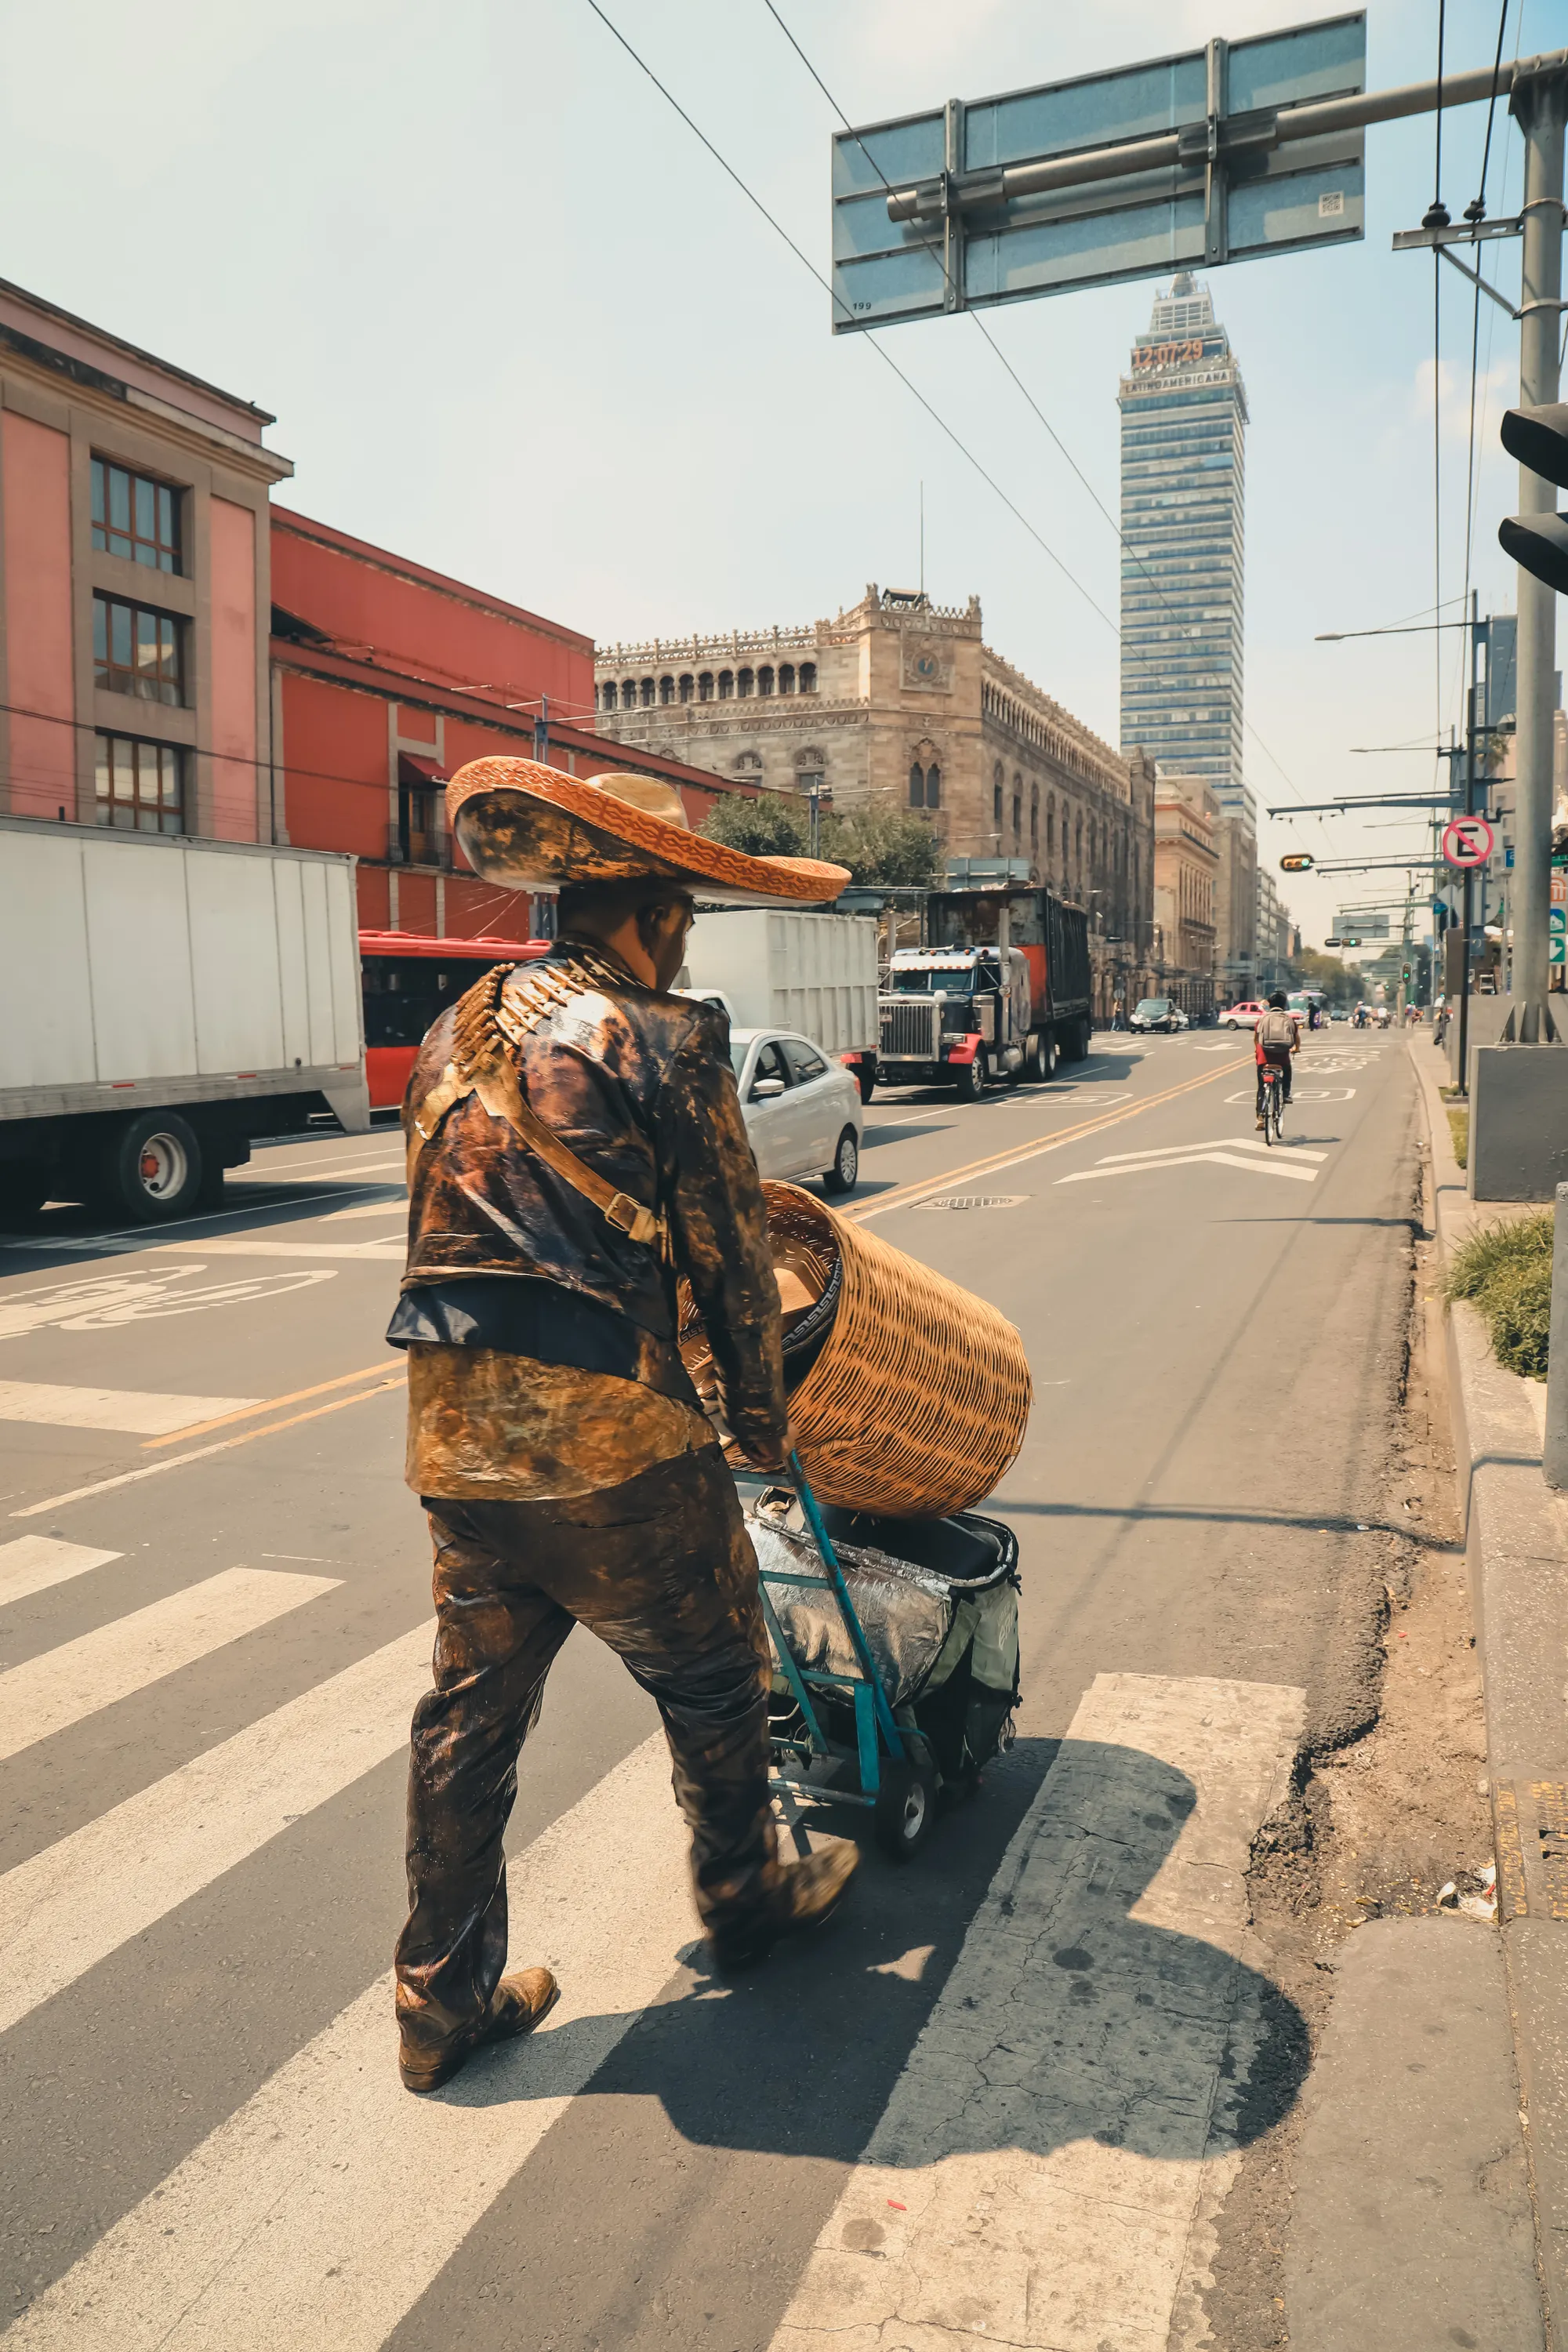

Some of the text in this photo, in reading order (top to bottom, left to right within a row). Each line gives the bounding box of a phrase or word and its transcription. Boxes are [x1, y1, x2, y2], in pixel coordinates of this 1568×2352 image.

[1134, 339, 1203, 368] 12:07:29
[1126, 371, 1228, 392] LATINOAMERICANA
[1457, 827, 1479, 856] E
